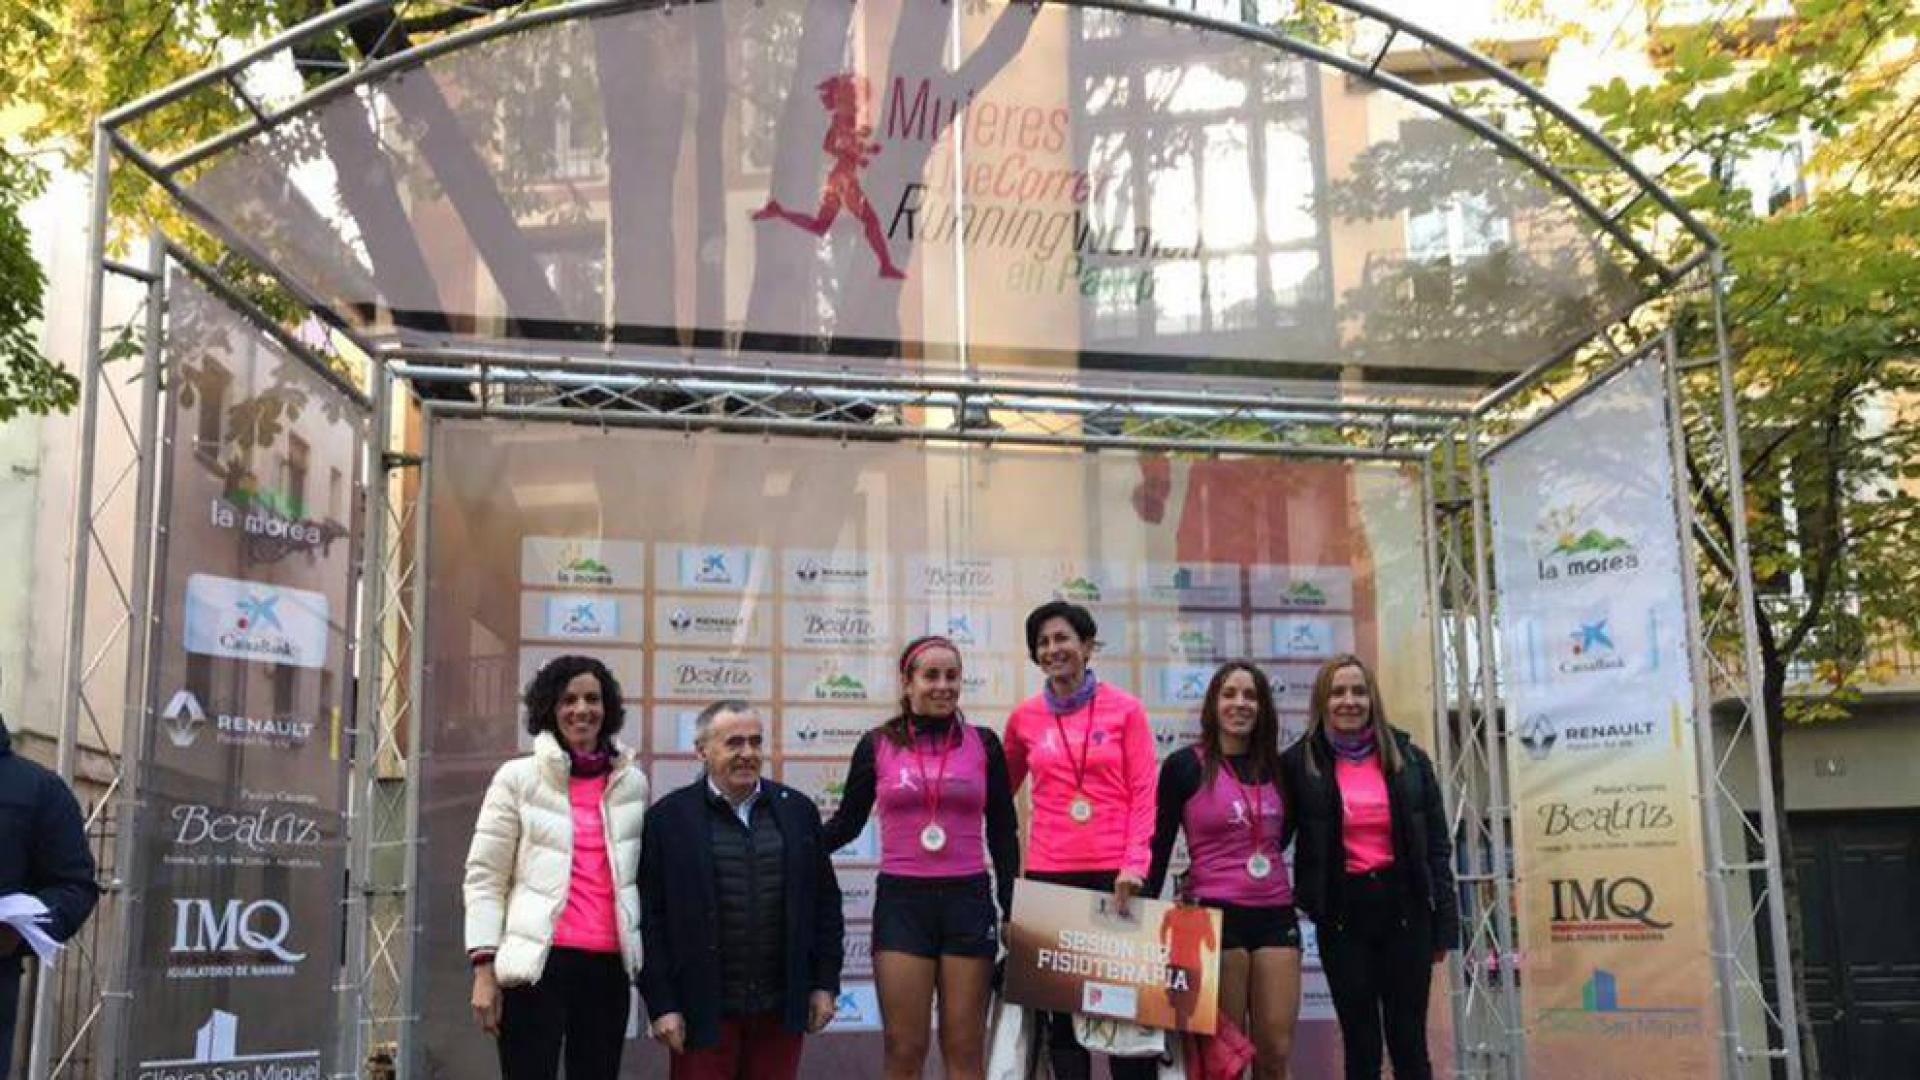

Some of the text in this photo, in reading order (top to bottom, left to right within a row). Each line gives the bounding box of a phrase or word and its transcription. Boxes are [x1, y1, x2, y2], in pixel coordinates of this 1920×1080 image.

[211, 499, 321, 544] la morea
[1538, 551, 1640, 580] la morea
[217, 714, 314, 738] RENAULT
[1565, 721, 1656, 741] RENAULT
[171, 802, 321, 852] Beatriz
[1537, 799, 1674, 838] Beatriz
[1549, 875, 1674, 928] IMQ
[170, 898, 308, 962] IMQ
